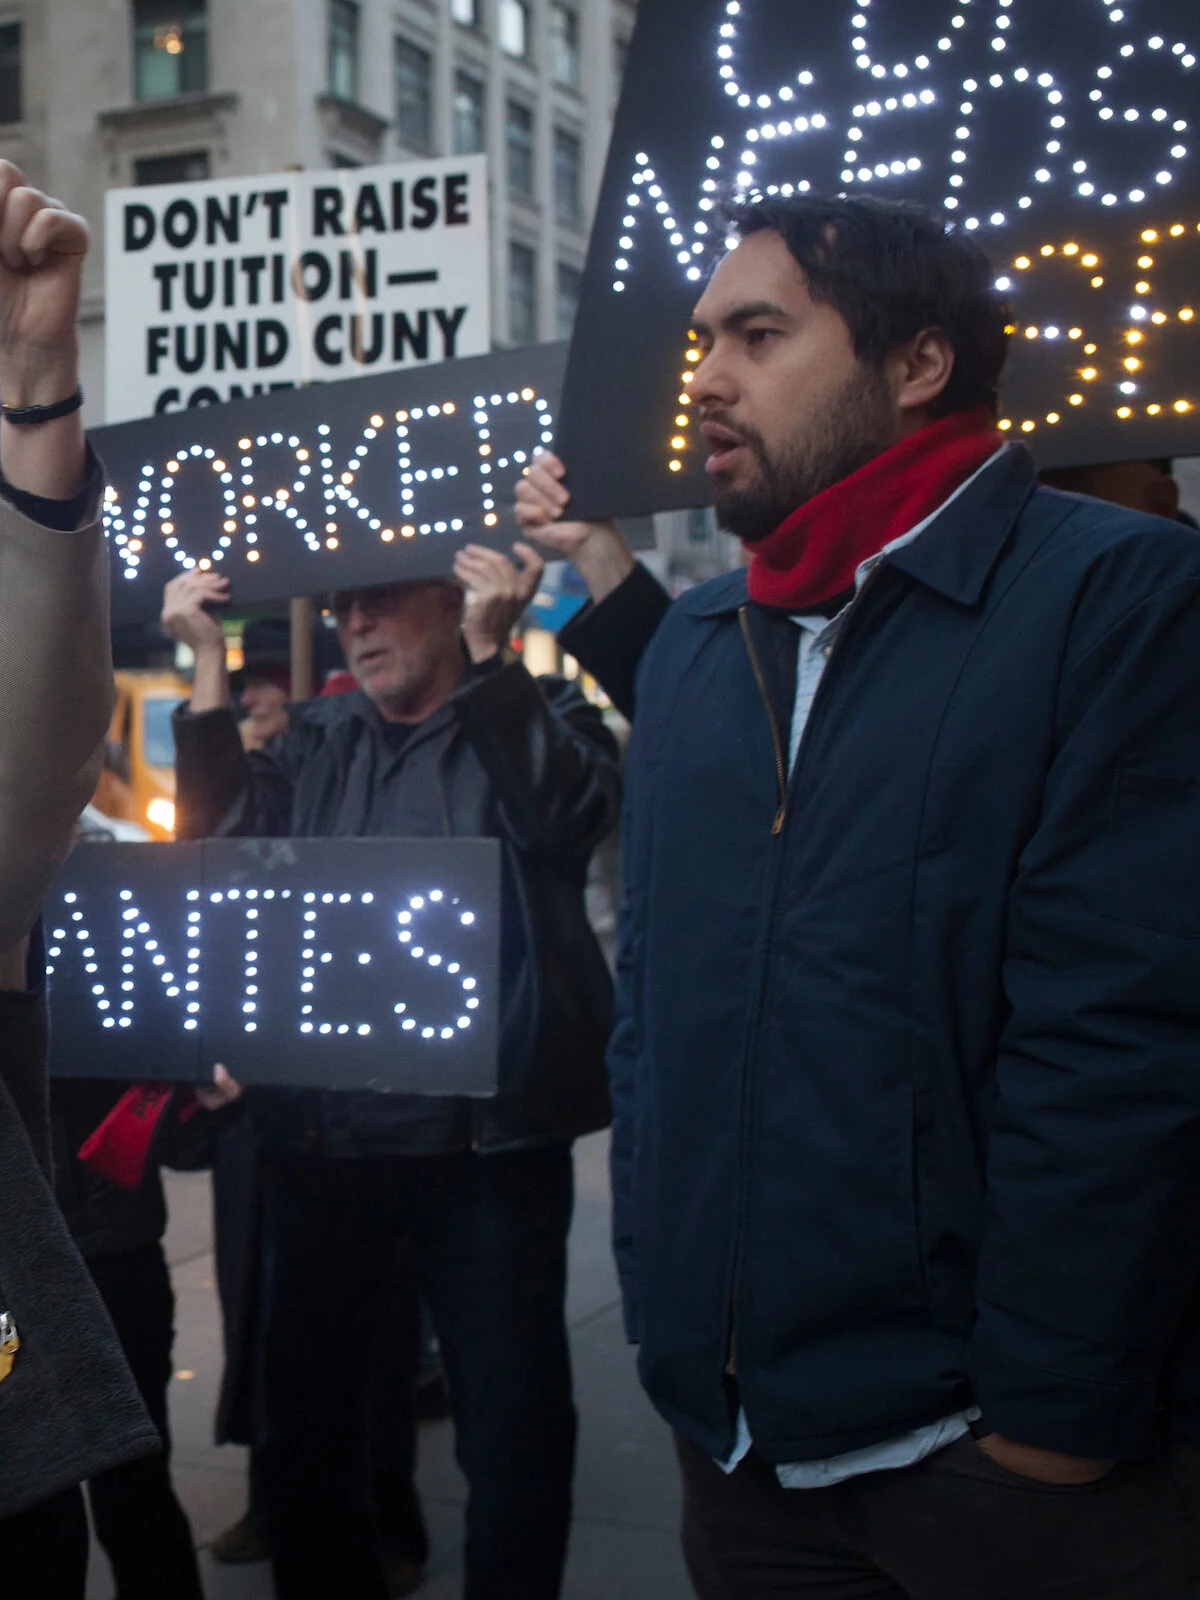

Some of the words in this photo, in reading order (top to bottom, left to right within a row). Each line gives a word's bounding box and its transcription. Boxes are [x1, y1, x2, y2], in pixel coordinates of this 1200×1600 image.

[124, 189, 289, 252] DON'T
[312, 173, 470, 237] RAISE
[146, 317, 289, 376] FUND
[313, 306, 469, 366] CUNY
